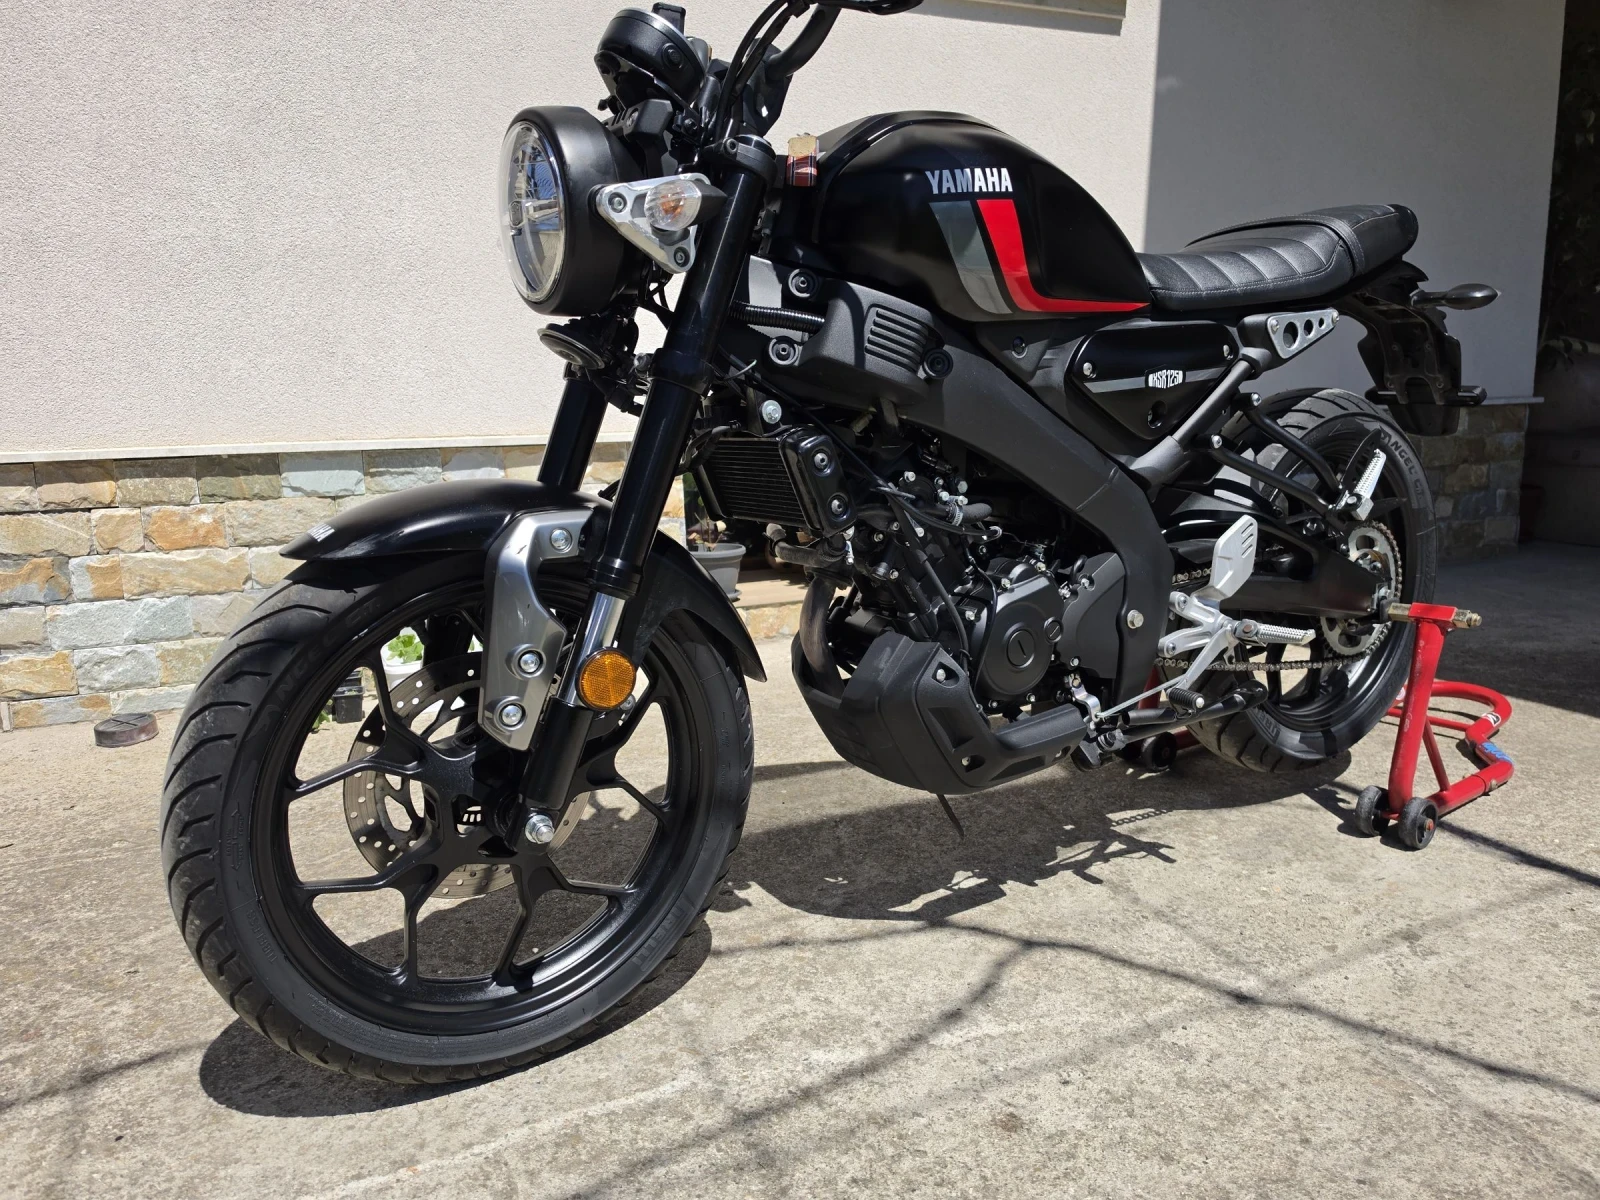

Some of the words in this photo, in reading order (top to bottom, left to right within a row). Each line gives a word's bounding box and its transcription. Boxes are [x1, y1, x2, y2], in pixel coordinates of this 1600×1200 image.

[925, 168, 1013, 194] YAMAHA
[1151, 369, 1181, 389] XSR125
[631, 897, 695, 972] PIRELLI
